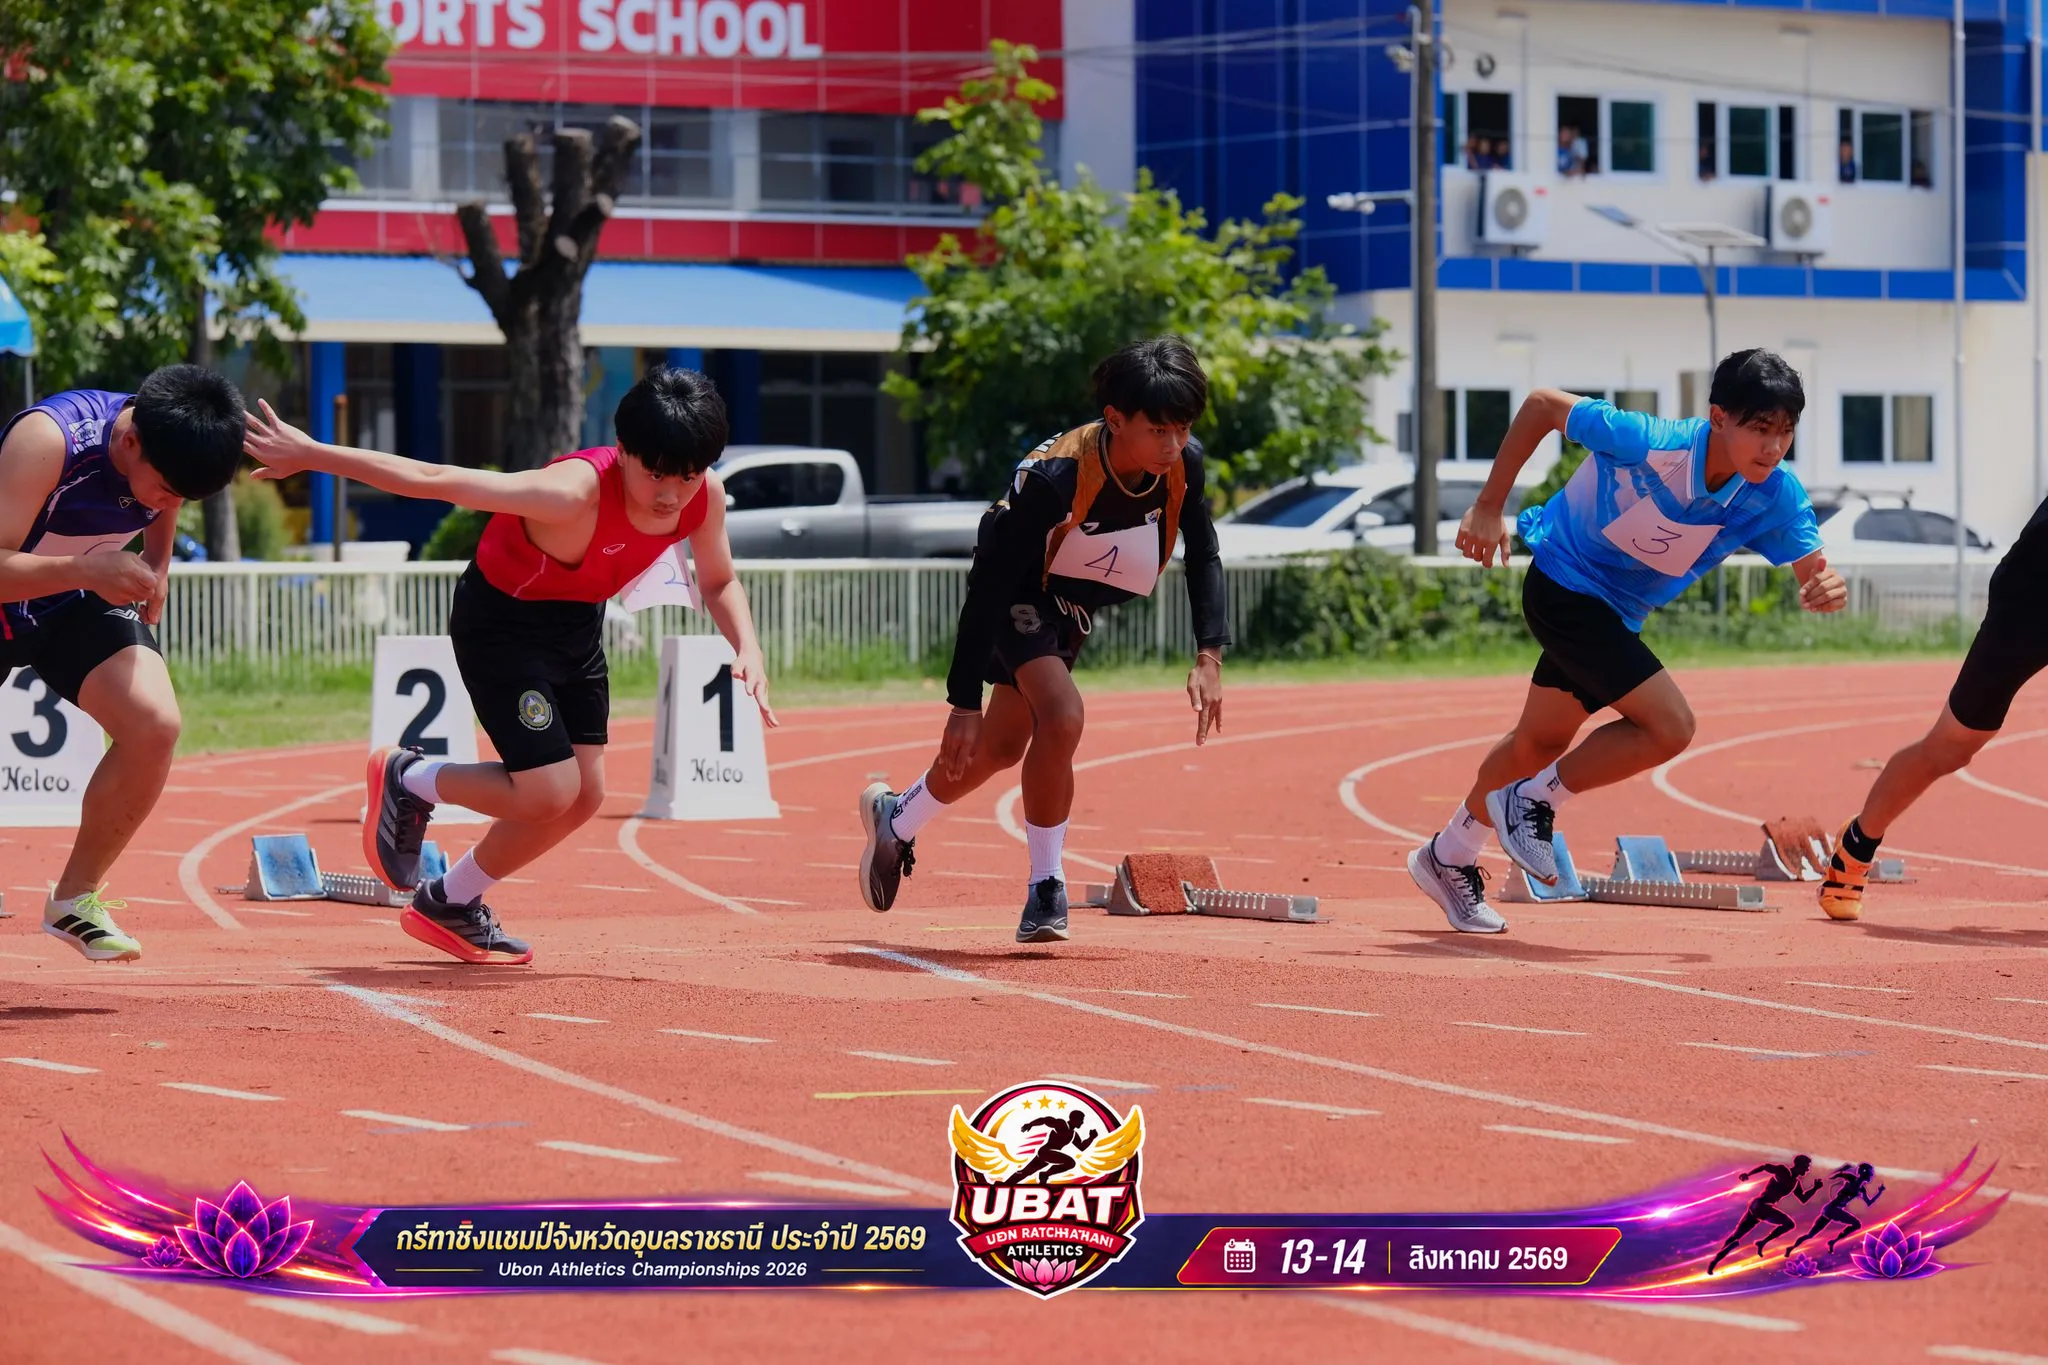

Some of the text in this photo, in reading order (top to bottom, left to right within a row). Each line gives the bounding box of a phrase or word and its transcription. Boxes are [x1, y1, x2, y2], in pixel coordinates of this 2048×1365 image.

[374, 0, 823, 60] ORTS SCHOOL
[1084, 545, 1122, 578] 4
[1632, 525, 1682, 555] 3
[10, 665, 68, 758] 3
[395, 668, 449, 756] 2
[703, 664, 734, 752] 1
[1, 766, 70, 792] Nelco
[691, 758, 744, 783] Nelco
